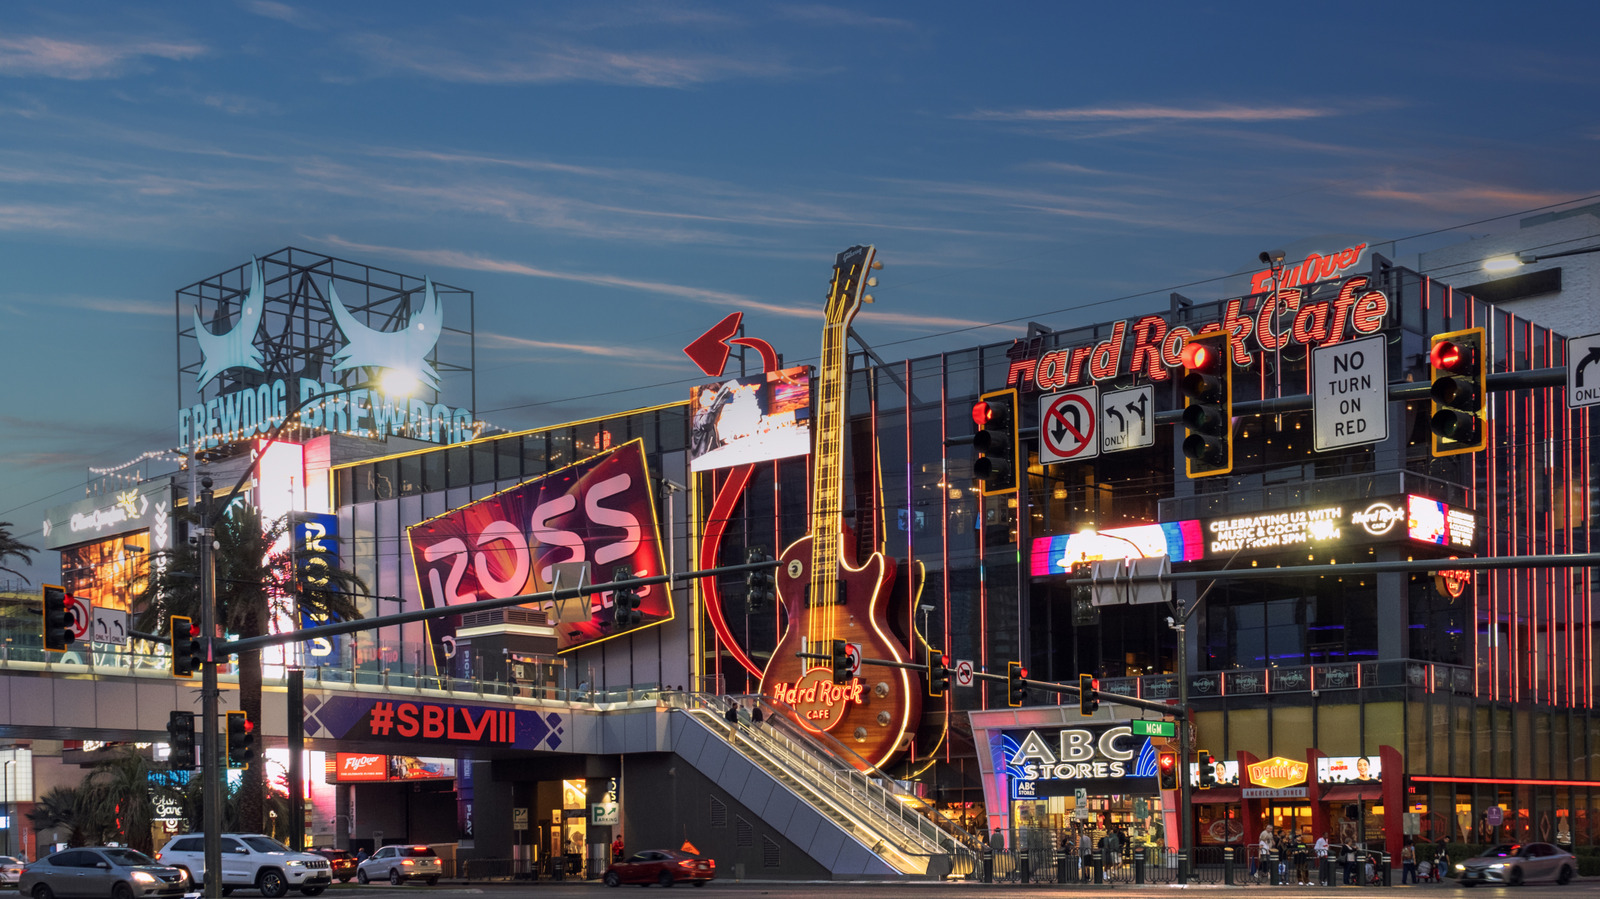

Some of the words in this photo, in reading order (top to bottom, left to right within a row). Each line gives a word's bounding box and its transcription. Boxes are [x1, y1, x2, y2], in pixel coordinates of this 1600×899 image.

[1247, 243, 1367, 308] FlyOver
[1006, 320, 1128, 393] Hard
[1255, 275, 1389, 353] Cafe
[1334, 351, 1364, 374] NO
[1329, 374, 1370, 395] TURN
[1575, 387, 1600, 402] ONL
[179, 378, 286, 453] BREWDOG
[300, 377, 473, 446] BREWDOG
[1340, 398, 1360, 415] ON
[1335, 418, 1366, 437] RED
[1104, 434, 1127, 447] ONLY
[1210, 513, 1289, 532] CELEBRATING
[1290, 511, 1306, 523] U2
[1307, 507, 1341, 521] WITH
[1352, 510, 1379, 524] Hard
[1379, 507, 1404, 522] Rock
[1217, 528, 1255, 541] MUSIC
[1256, 527, 1265, 537] &
[424, 473, 641, 619] ROSS
[1211, 538, 1244, 552] DAILY
[773, 680, 817, 704] Hard
[820, 678, 862, 706] Rock
[370, 702, 515, 743] #SBLVIII
[806, 709, 830, 720] CAFE
[1146, 723, 1162, 734] MGM
[1011, 726, 1133, 765] ABC
[344, 756, 379, 770] FlyOver
[1024, 762, 1125, 781] STORES
[1252, 764, 1303, 780] Denny's
[1018, 782, 1035, 791] ABC
